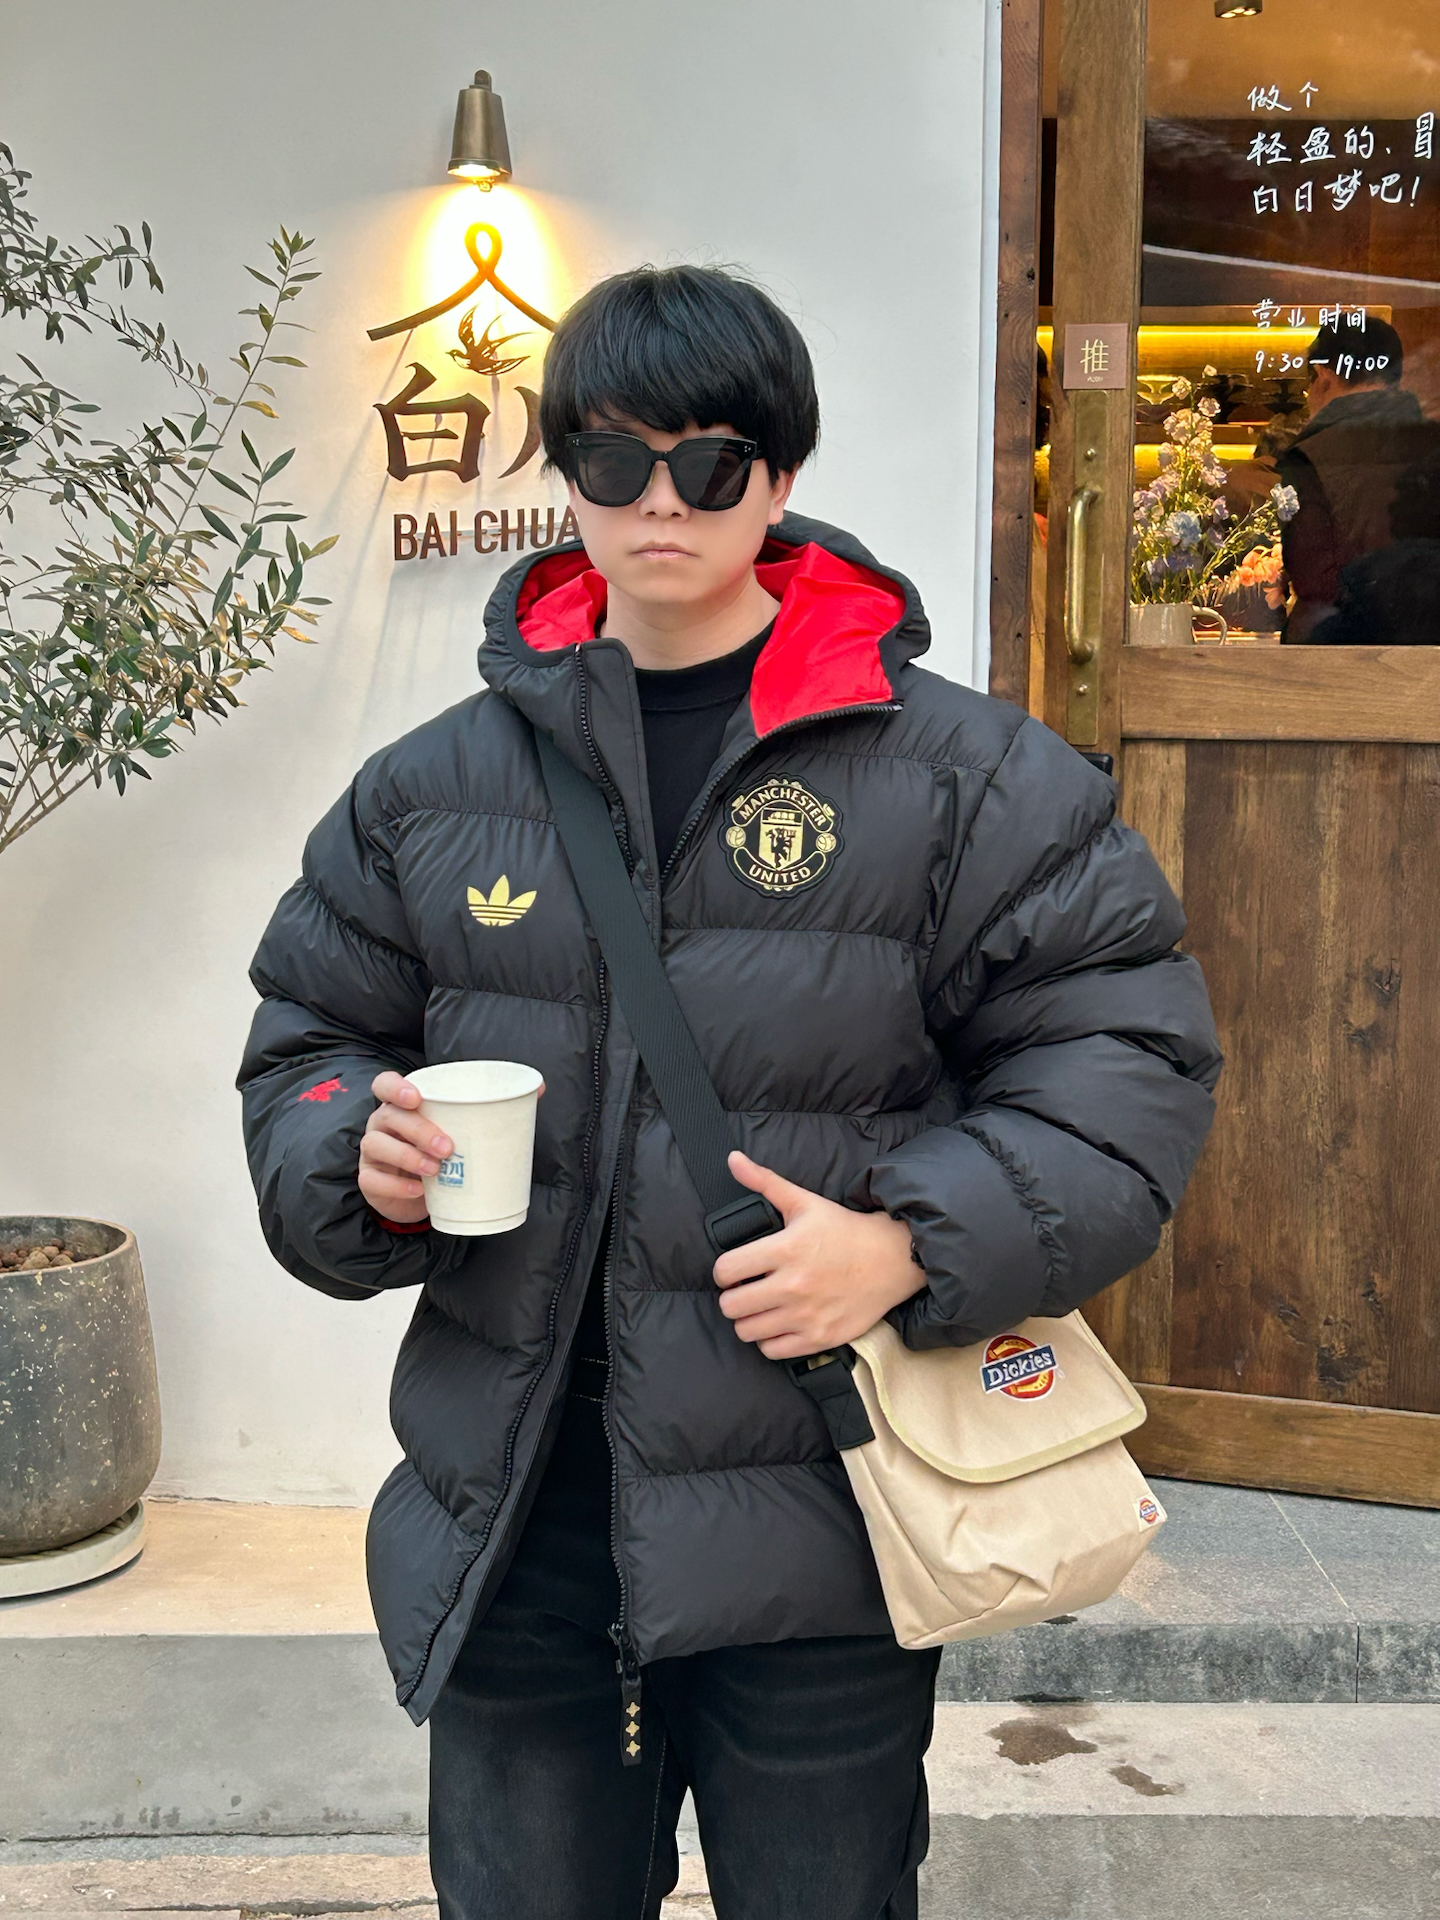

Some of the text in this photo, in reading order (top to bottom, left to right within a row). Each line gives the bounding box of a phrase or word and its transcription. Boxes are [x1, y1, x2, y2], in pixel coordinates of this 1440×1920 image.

[1247, 81, 1319, 112] 做个
[1252, 298, 1366, 334] 营业时间
[1080, 339, 1109, 375] 推
[373, 362, 541, 483] 白
[393, 510, 458, 561] BAI
[738, 787, 828, 827] MANCHESTER
[748, 864, 811, 884] UNITED
[987, 1352, 1053, 1386] Dickies
